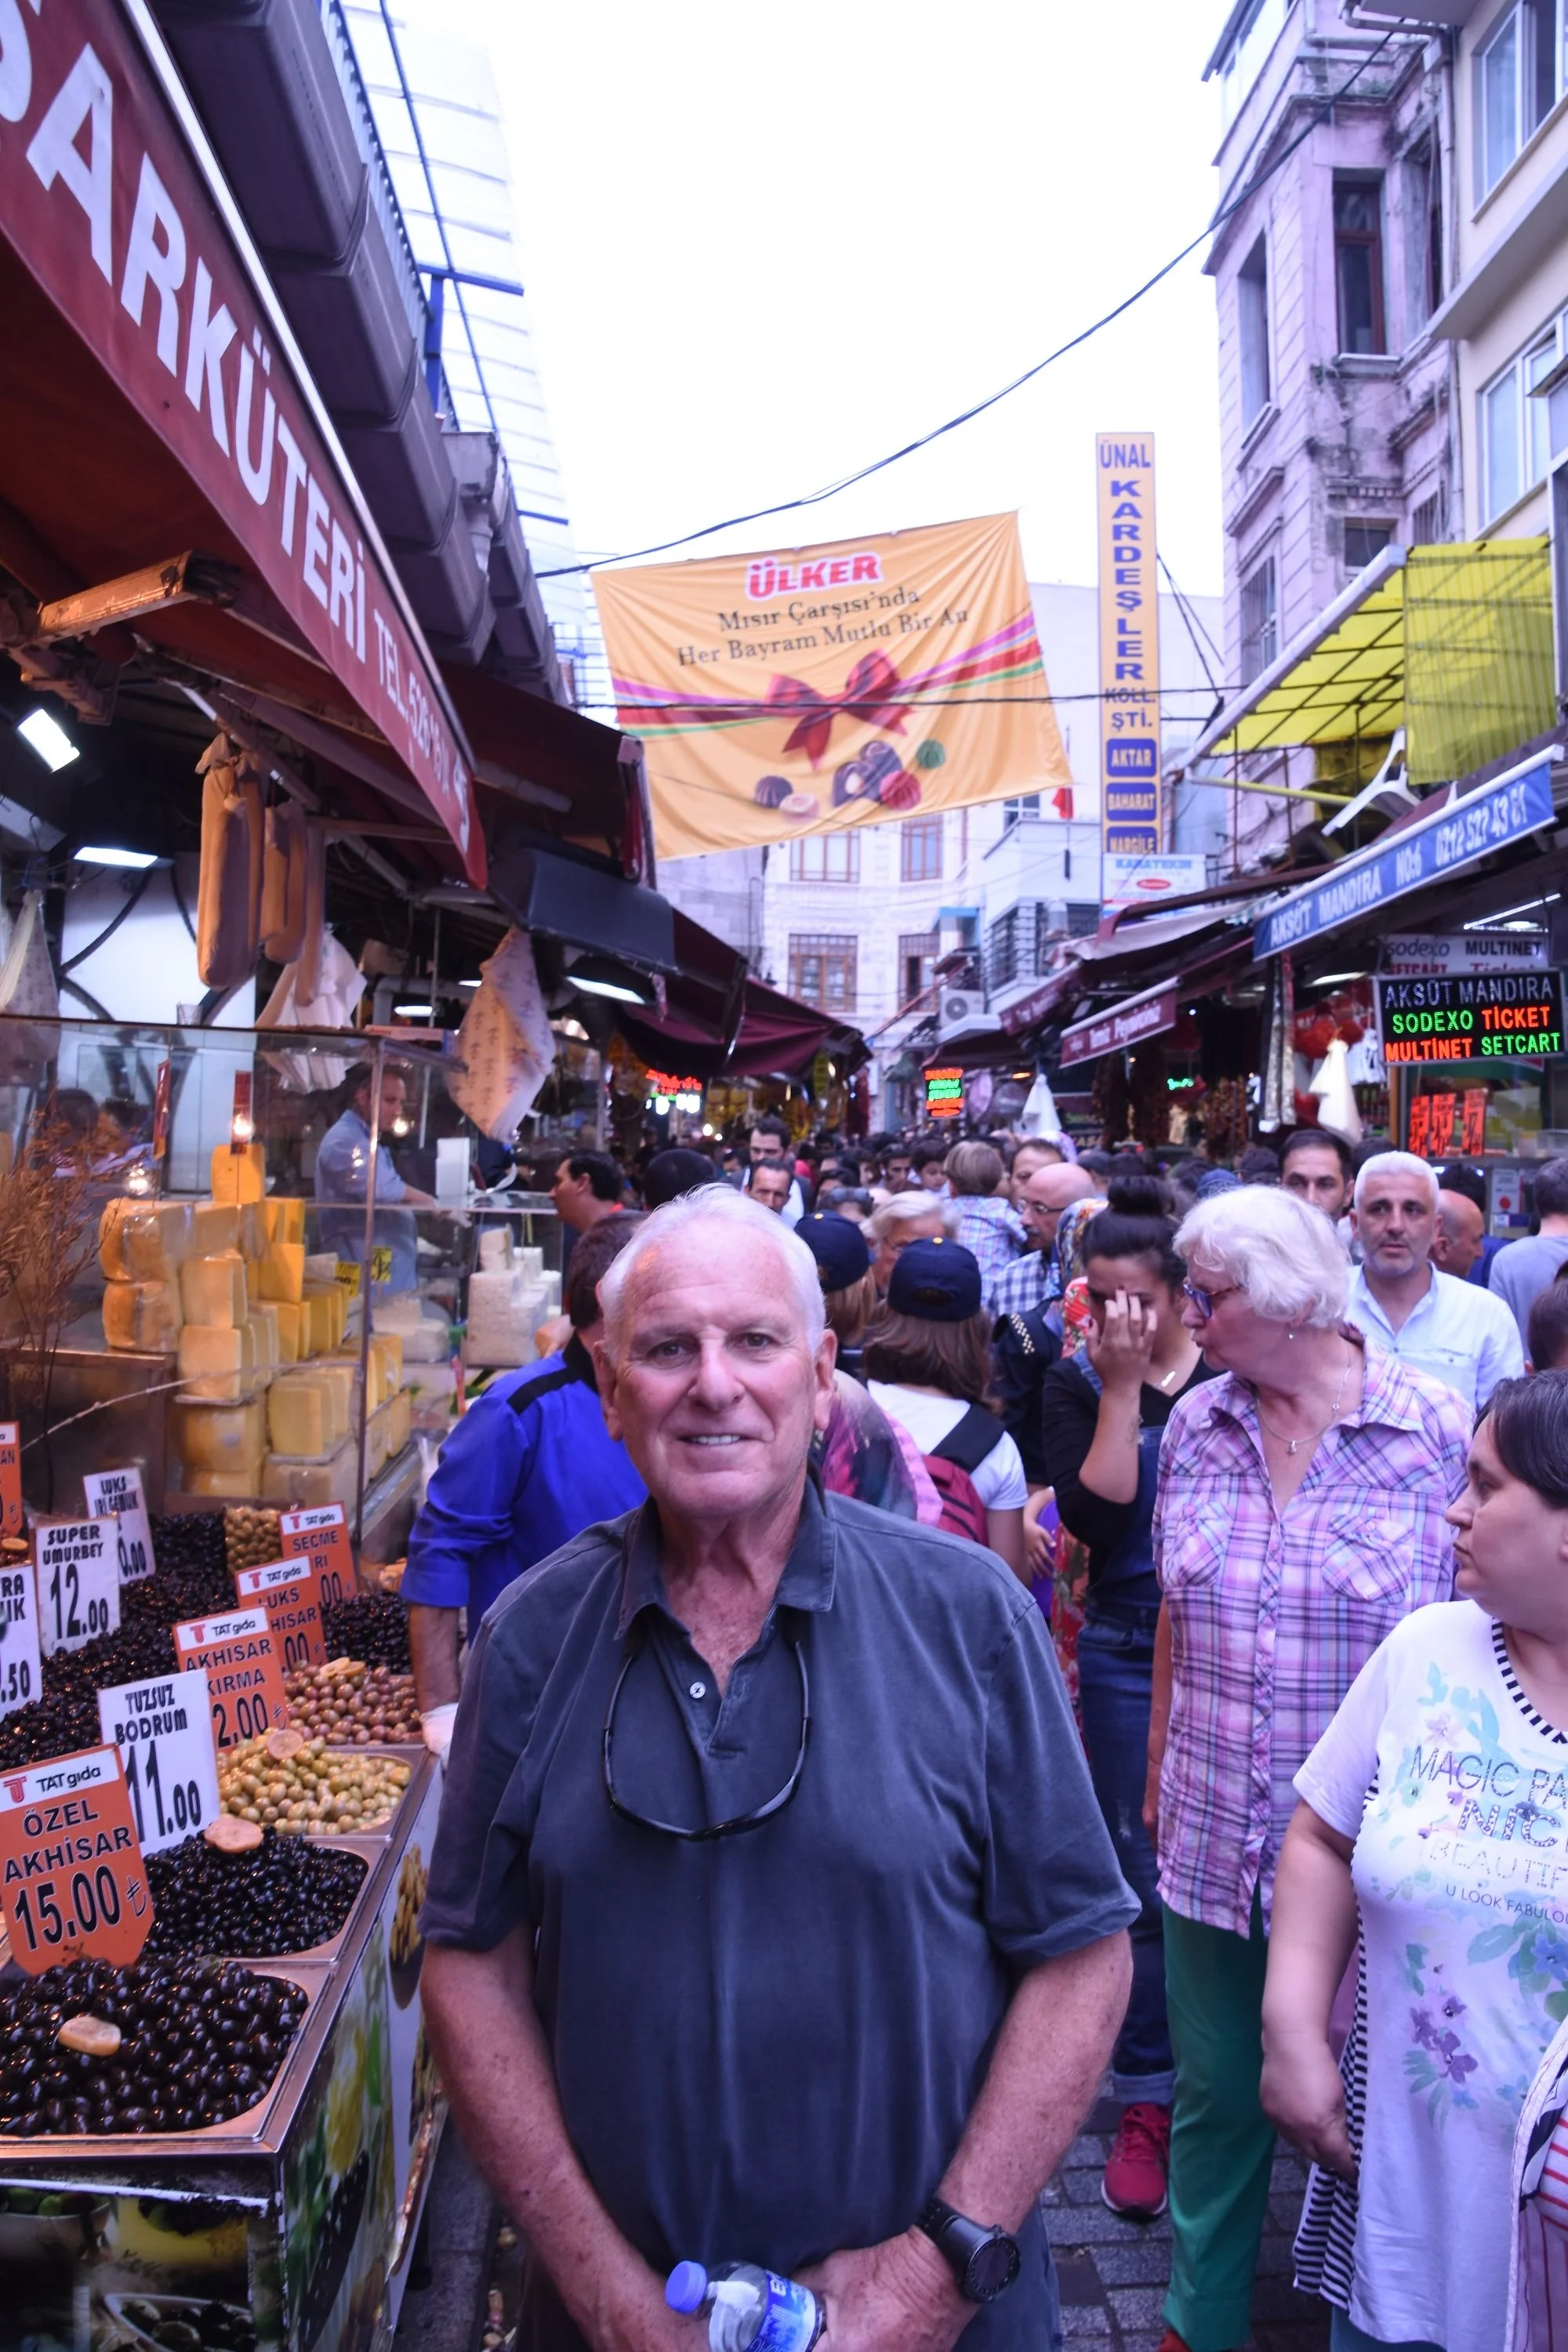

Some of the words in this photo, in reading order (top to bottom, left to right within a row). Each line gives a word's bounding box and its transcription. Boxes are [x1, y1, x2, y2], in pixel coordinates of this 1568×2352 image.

[1100, 440, 1151, 469] ÜNAL
[748, 554, 881, 598] ÜLKER
[1111, 480, 1145, 681] KARDEŞLER
[677, 644, 720, 666] Her
[728, 636, 818, 662] Bayram
[822, 622, 891, 646] Mutlu
[898, 612, 933, 634] Bir
[940, 607, 969, 627] An
[718, 608, 780, 633] Mısır
[1110, 748, 1152, 768] AKTAR
[1107, 793, 1155, 811] BAHARAT
[1270, 899, 1312, 948] AKSÜT
[1318, 866, 1382, 924] MANDIRA
[1387, 938, 1450, 956] sodexo
[1385, 979, 1453, 1009] AKSÜT
[1458, 976, 1554, 1004] MANDIRA
[1392, 1009, 1473, 1034] SODEXO
[1480, 1032, 1561, 1056] SETCART
[48, 1524, 100, 1546] SUPER
[50, 1563, 108, 1639] 12.00
[185, 1638, 273, 1671] AKHİSAR
[125, 1683, 176, 1715] TUZSUZ
[36, 1772, 67, 1794] TAT
[1410, 1745, 1519, 1797] MAGIC
[125, 1740, 202, 1844] 11.00
[23, 1799, 100, 1838] ÖZEL
[1457, 1798, 1568, 1853] NIC
[4, 1826, 134, 1883] AKHİSAR
[14, 1864, 121, 1951] 15.00
[1446, 1883, 1456, 1896] U
[1461, 1887, 1501, 1909] LOOK
